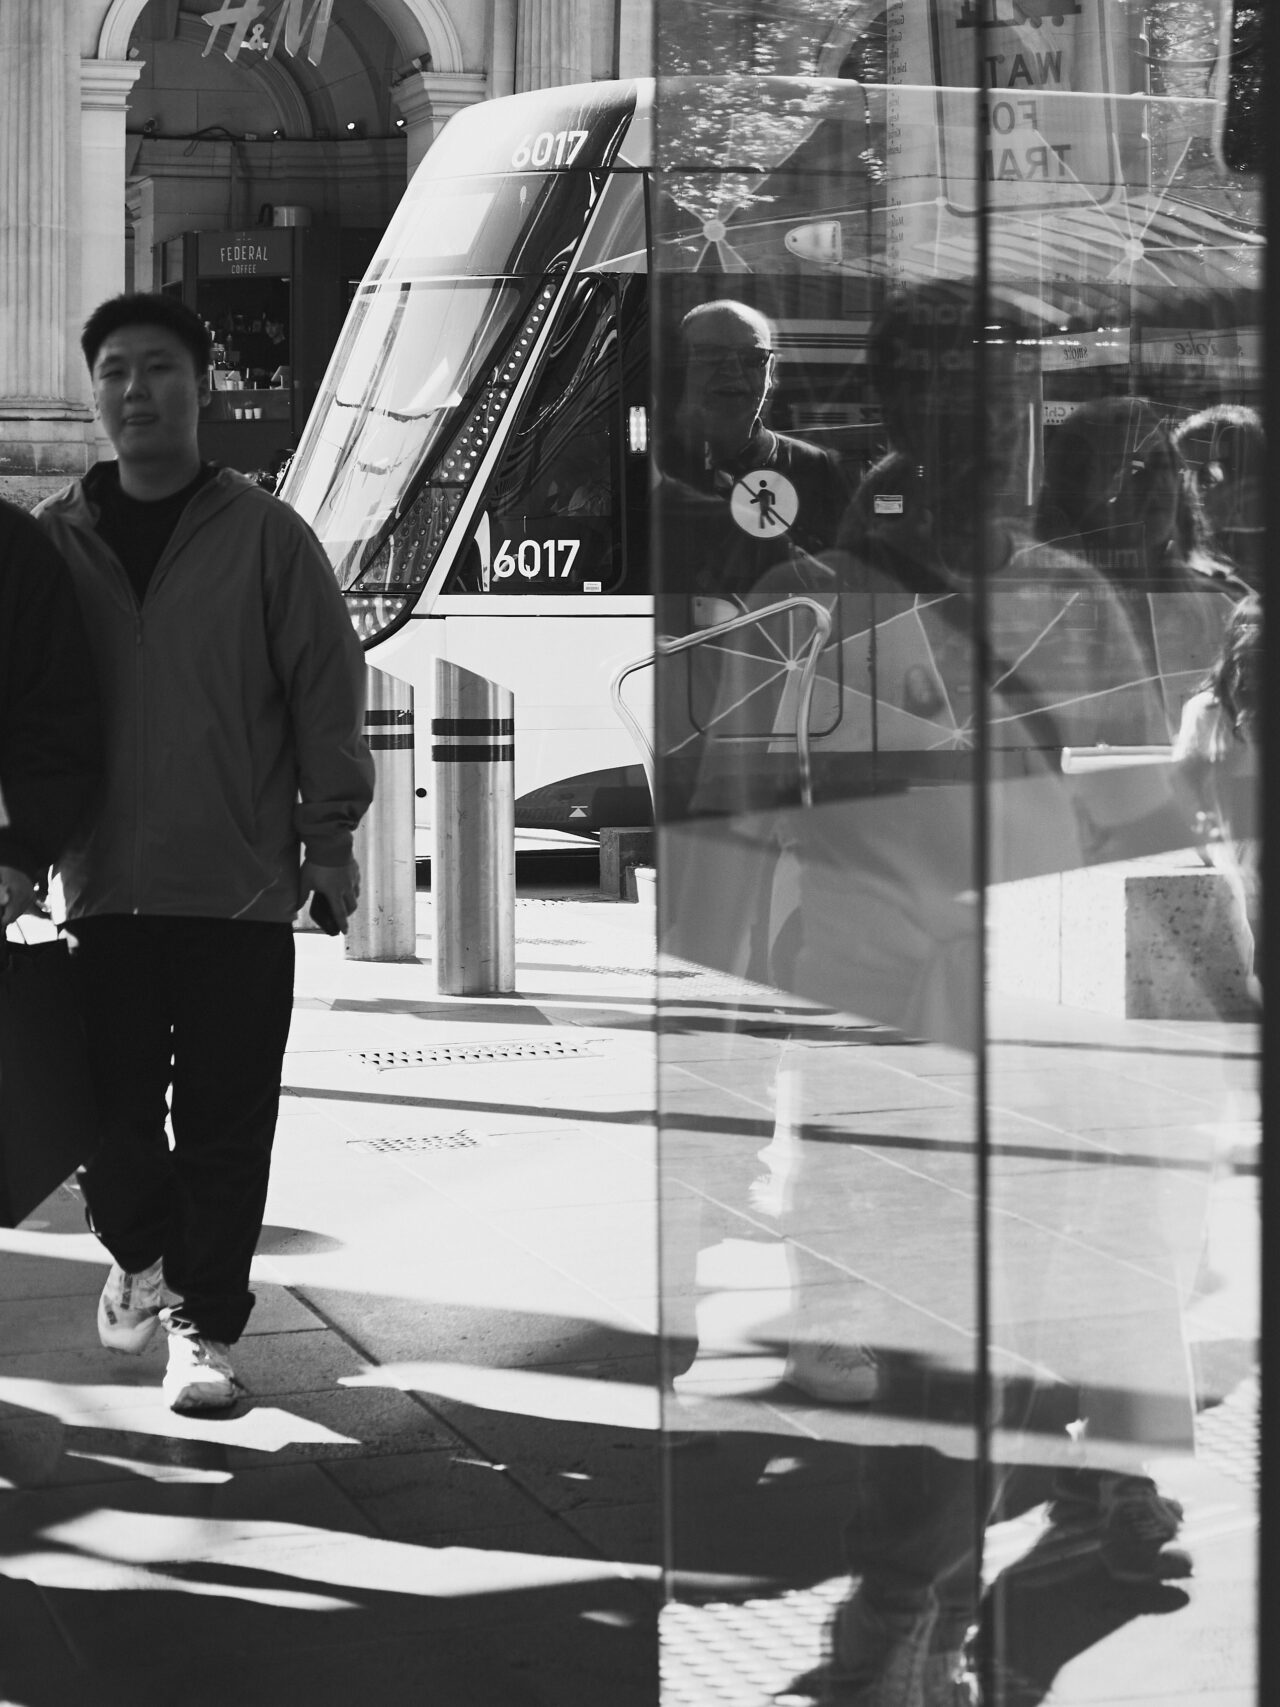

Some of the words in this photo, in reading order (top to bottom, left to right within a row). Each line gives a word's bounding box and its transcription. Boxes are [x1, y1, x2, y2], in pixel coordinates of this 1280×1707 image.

[511, 130, 589, 168] 6017
[220, 245, 268, 263] FEDERAL
[231, 263, 257, 274] COFFEE
[493, 539, 581, 578] 6017
